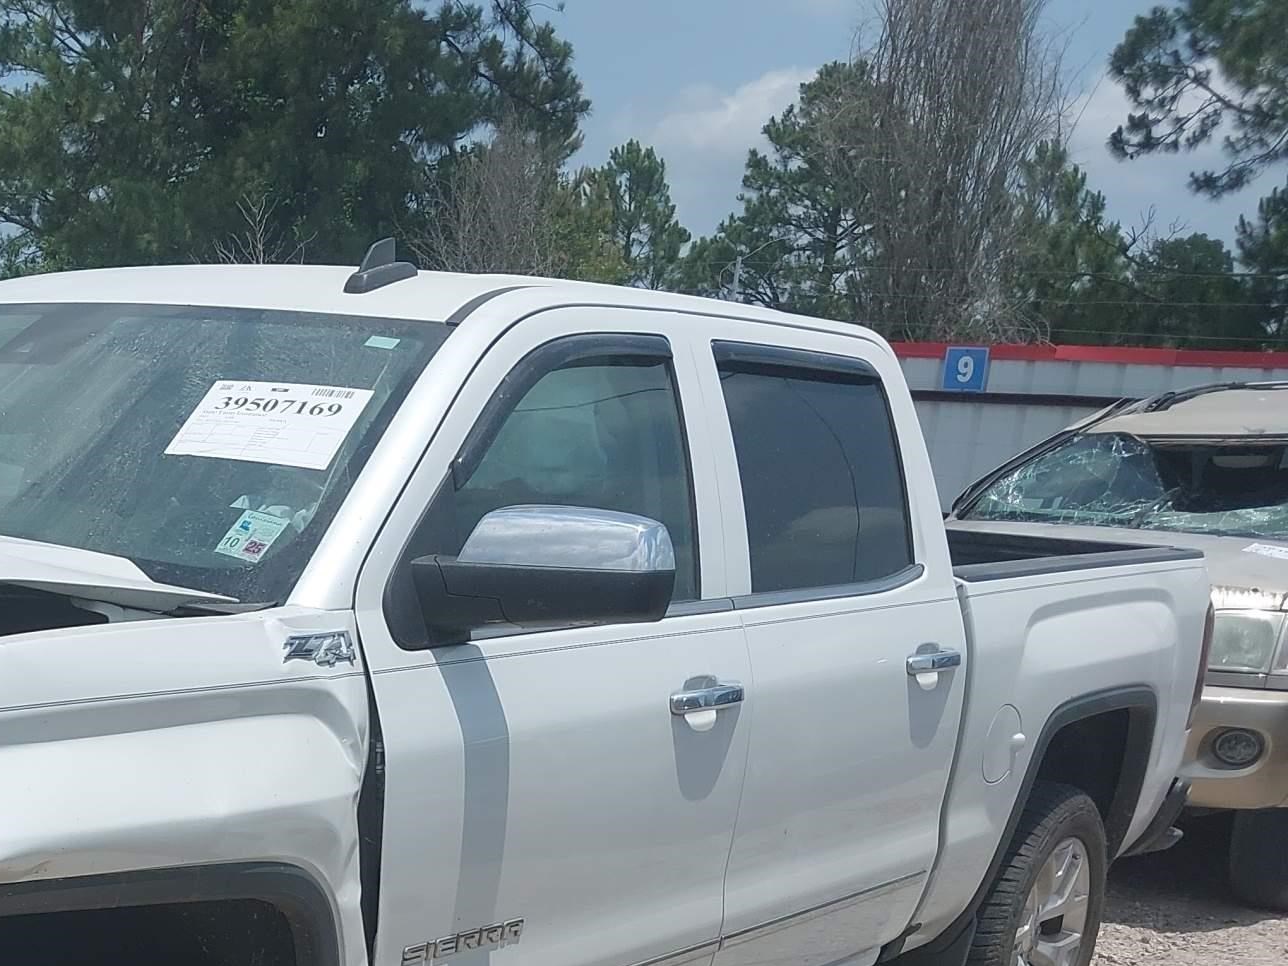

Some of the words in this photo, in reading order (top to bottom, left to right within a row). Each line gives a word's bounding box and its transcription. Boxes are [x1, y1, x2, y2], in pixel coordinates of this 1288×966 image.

[956, 355, 974, 383] 9
[214, 396, 343, 418] 39507169
[223, 536, 240, 548] 10
[243, 541, 266, 554] 25
